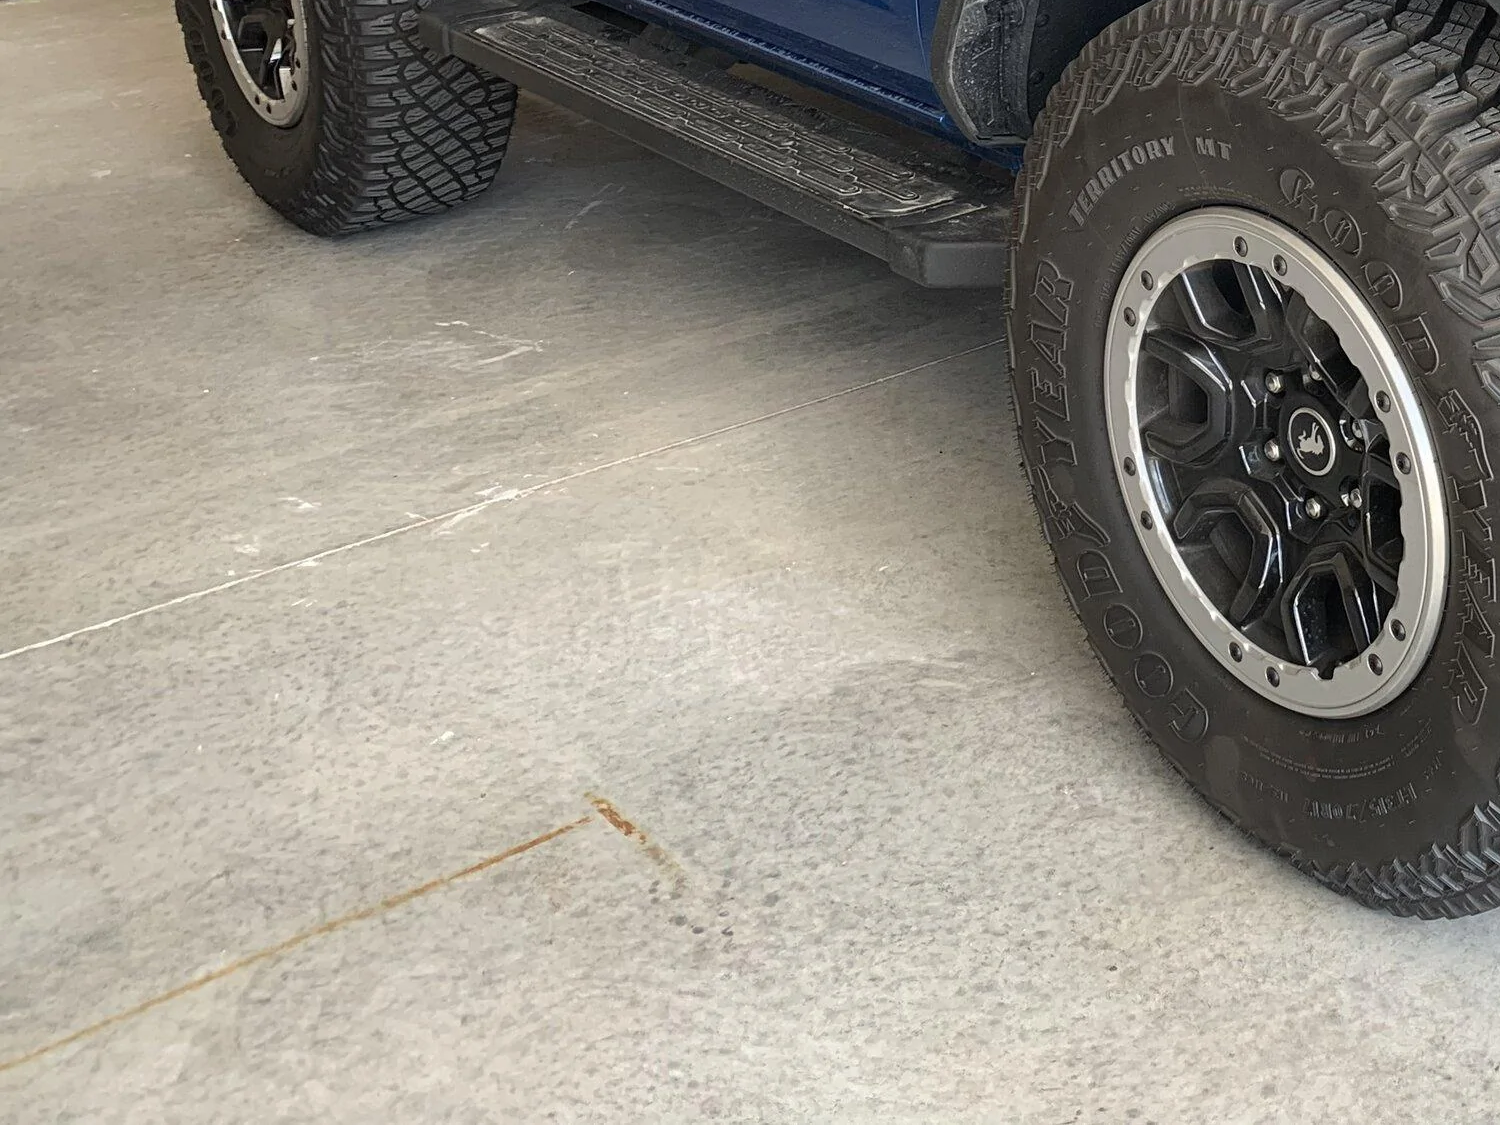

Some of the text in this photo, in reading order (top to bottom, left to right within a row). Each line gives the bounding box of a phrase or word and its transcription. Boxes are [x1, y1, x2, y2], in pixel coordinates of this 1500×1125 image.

[1067, 135, 1176, 227] TERRITORY
[1195, 135, 1233, 162] MT
[1025, 259, 1209, 744] GOODYEAR
